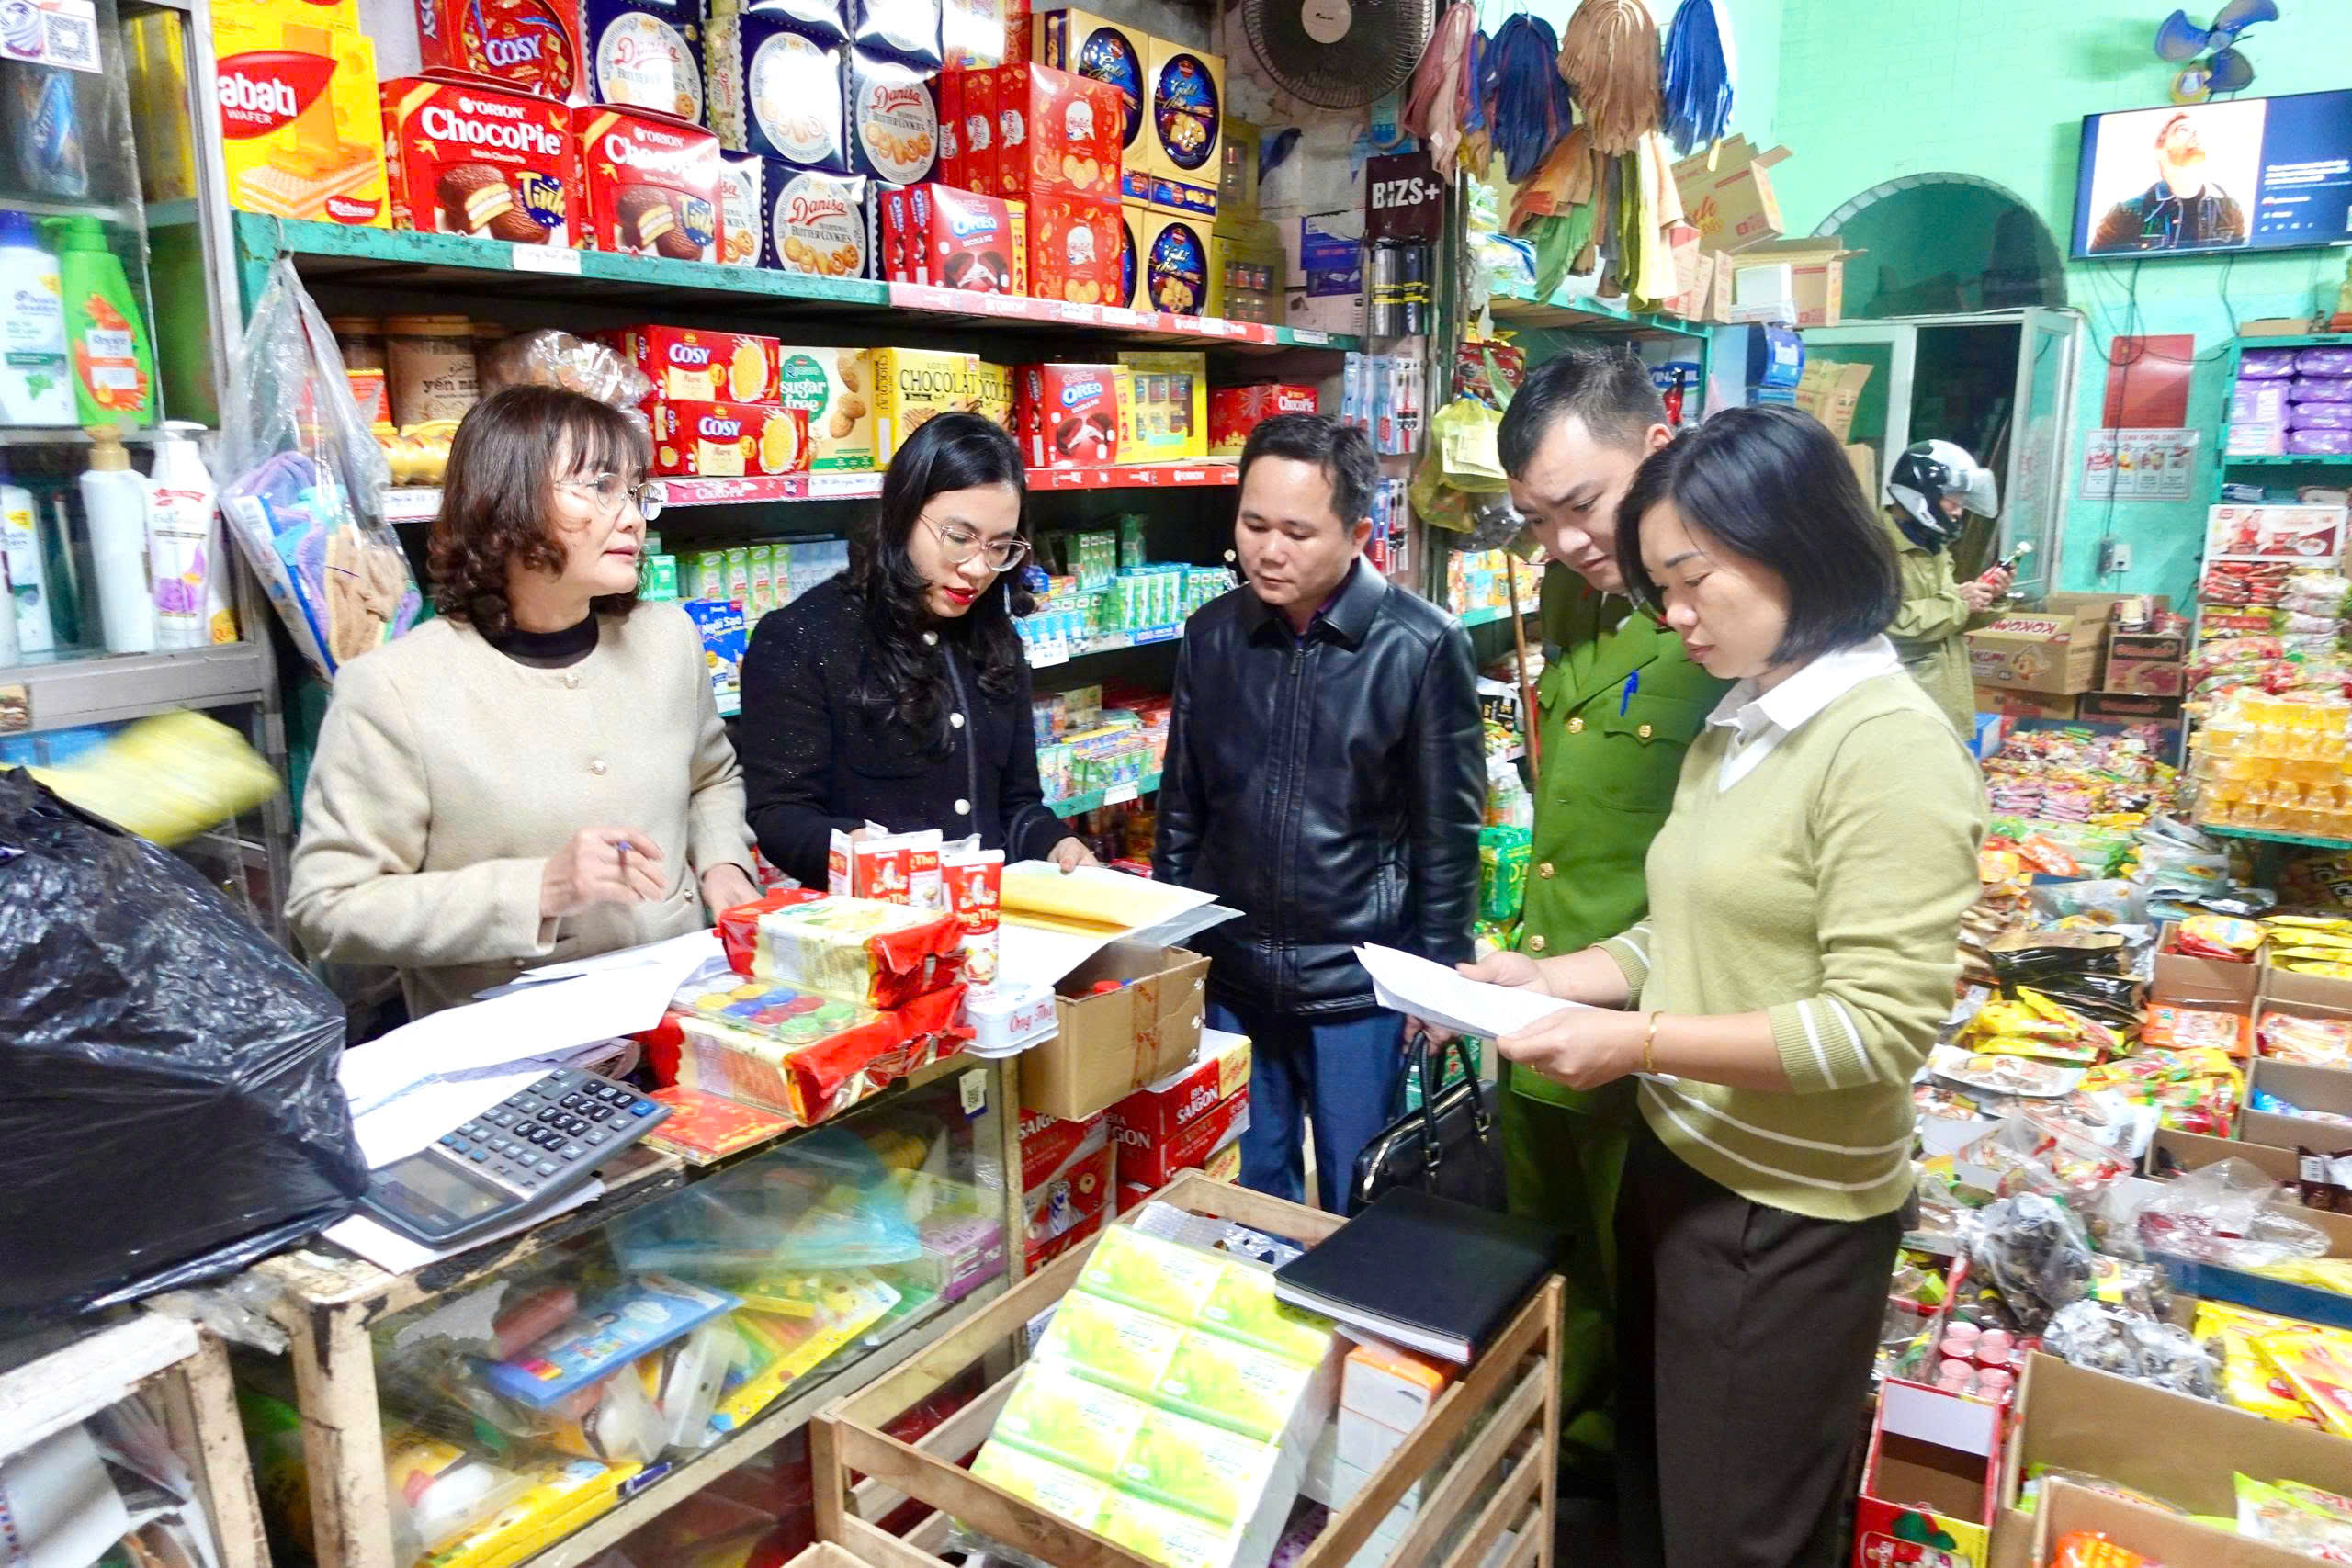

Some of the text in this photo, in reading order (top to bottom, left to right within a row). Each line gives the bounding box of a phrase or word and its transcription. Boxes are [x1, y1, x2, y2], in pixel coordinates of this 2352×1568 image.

[485, 34, 543, 67] COSY
[217, 72, 298, 118] abati
[868, 85, 922, 112] Danisa
[226, 108, 273, 125] WAFER
[475, 99, 526, 120] ORION
[420, 106, 563, 156] ChocoPie
[787, 197, 847, 225] Danisa
[668, 343, 711, 365] COSY
[780, 378, 825, 400] sugar
[900, 369, 978, 394] CHOCOLAT
[784, 393, 820, 412] free
[1061, 382, 1103, 408] OREO
[698, 416, 741, 437] COSY
[1176, 1086, 1220, 1125] SAIGON
[1018, 1111, 1058, 1140] SAIG
[1112, 1126, 1152, 1149] GON
